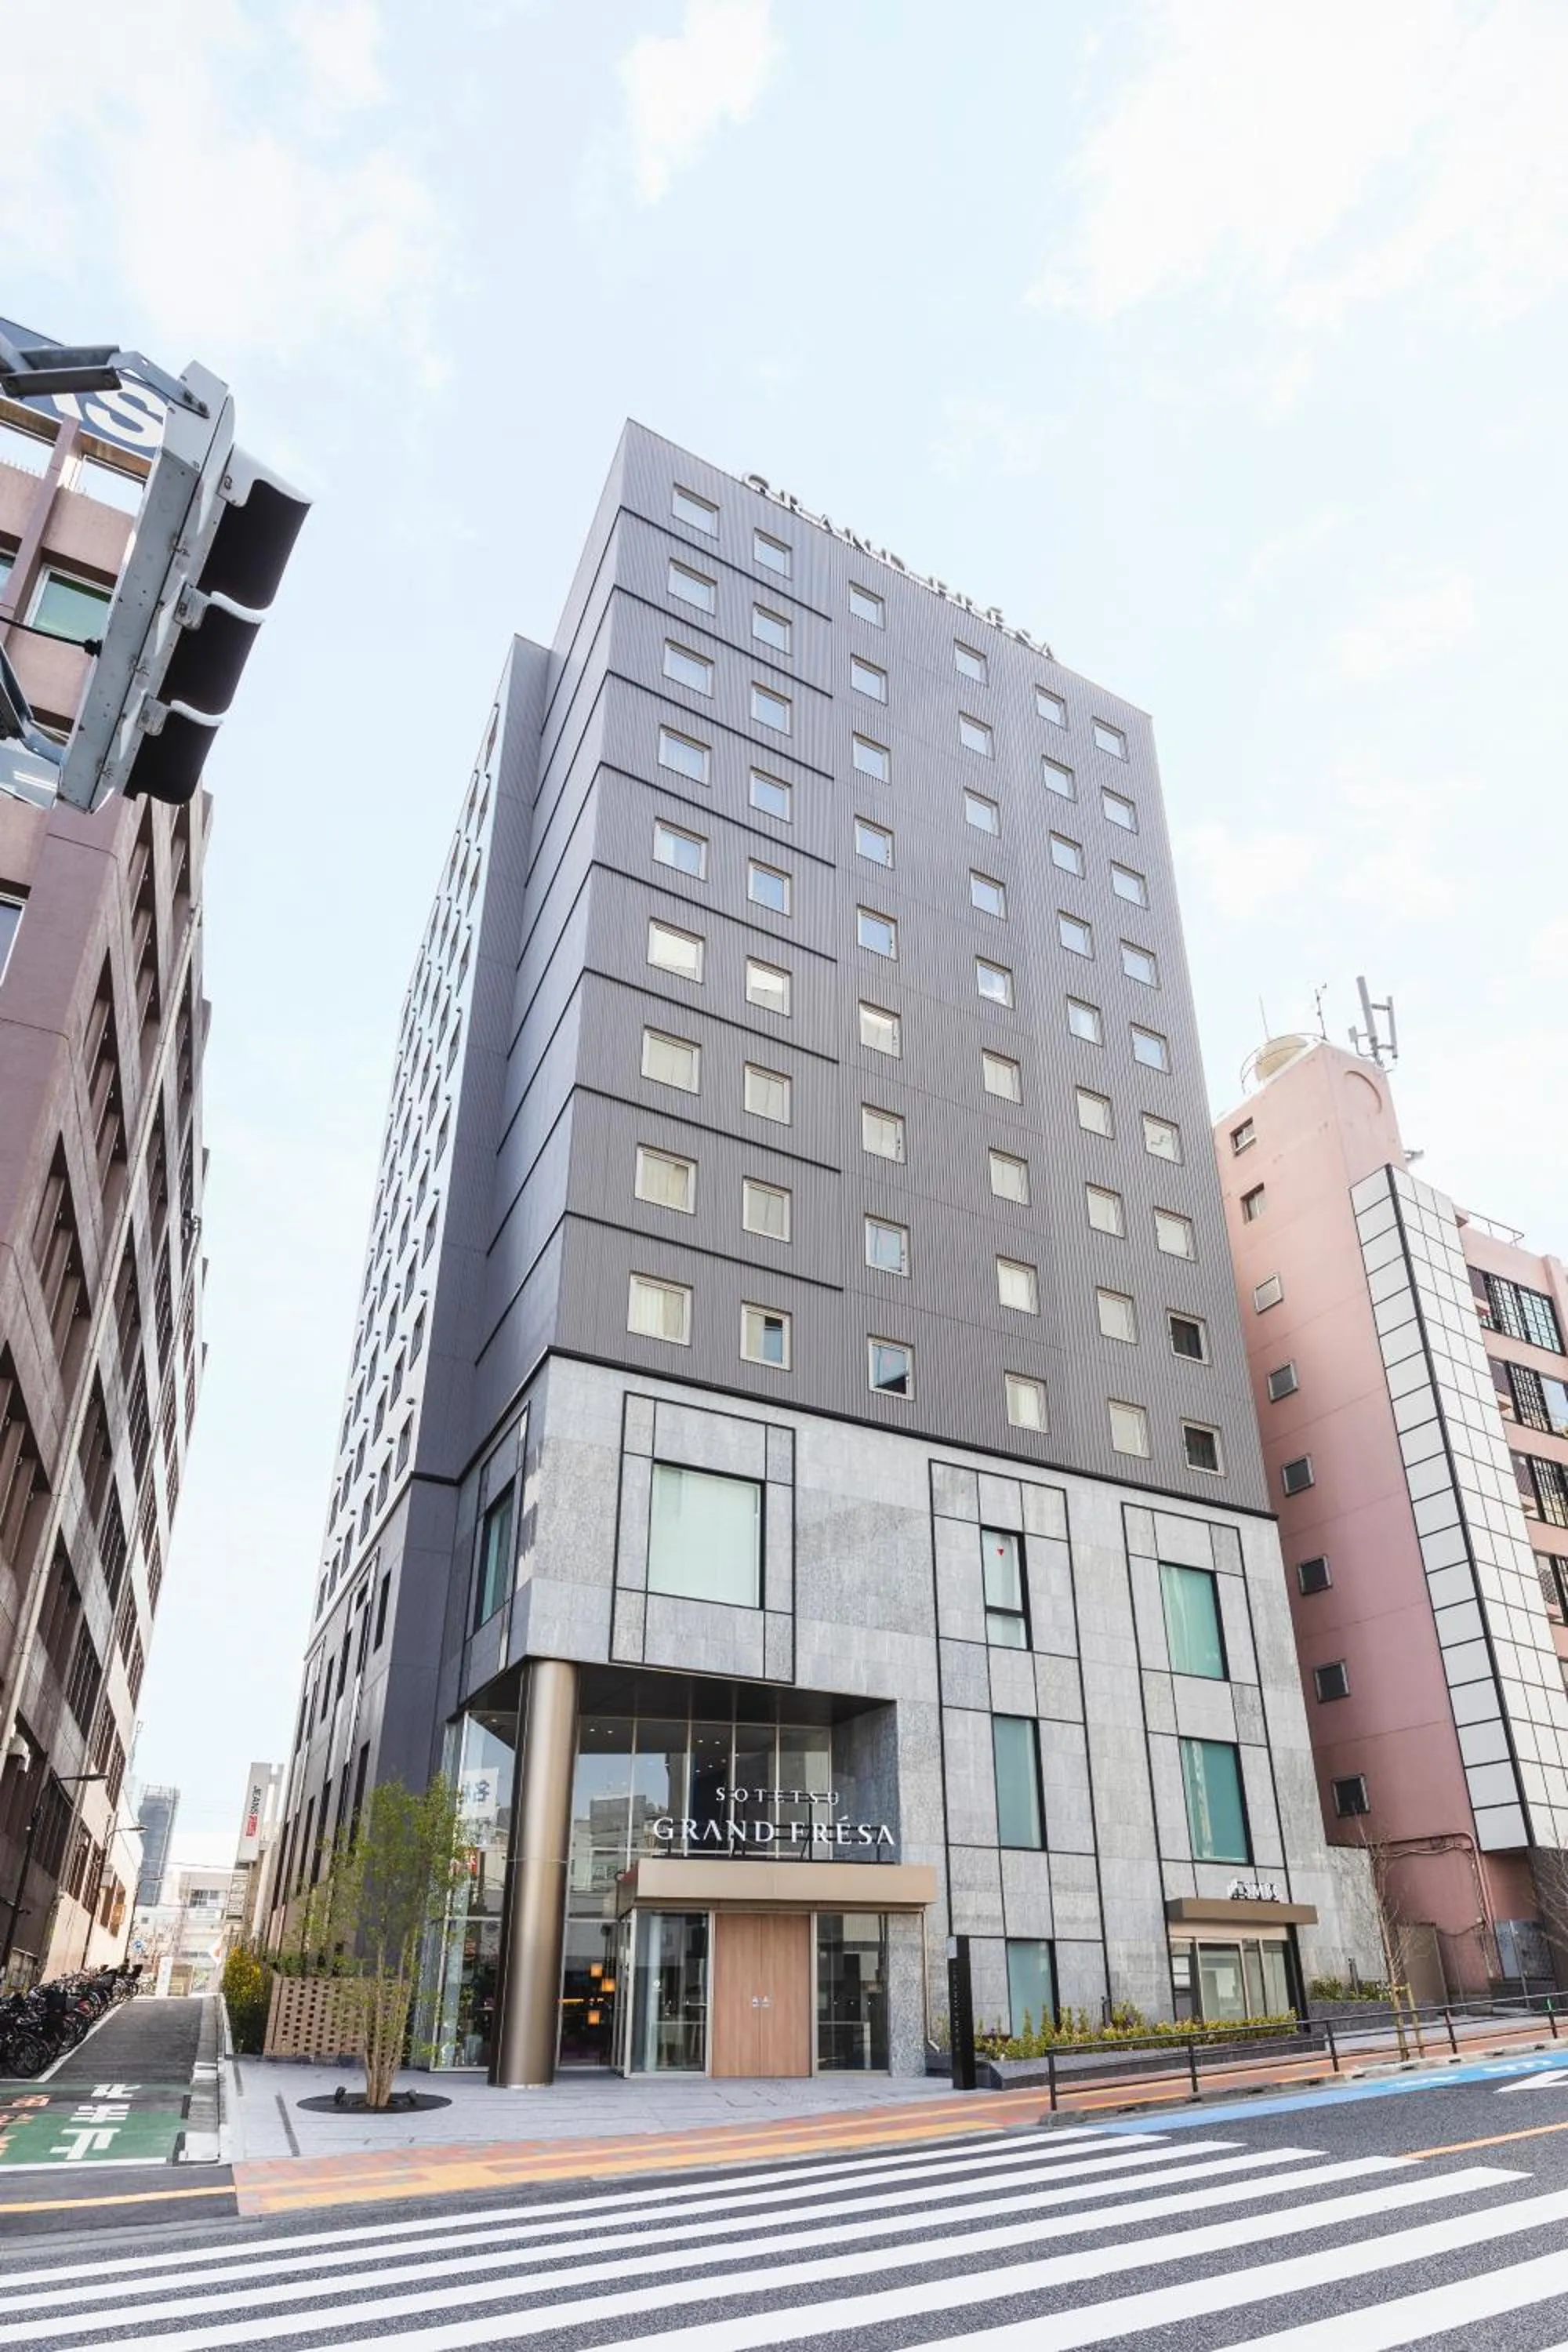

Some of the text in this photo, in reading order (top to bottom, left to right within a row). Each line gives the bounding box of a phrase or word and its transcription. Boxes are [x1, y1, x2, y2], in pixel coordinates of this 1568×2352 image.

[250, 1785, 262, 1814] JEANS
[716, 1787, 838, 1806] SOTETSU
[653, 1815, 895, 1845] GRAND FRÉSA
